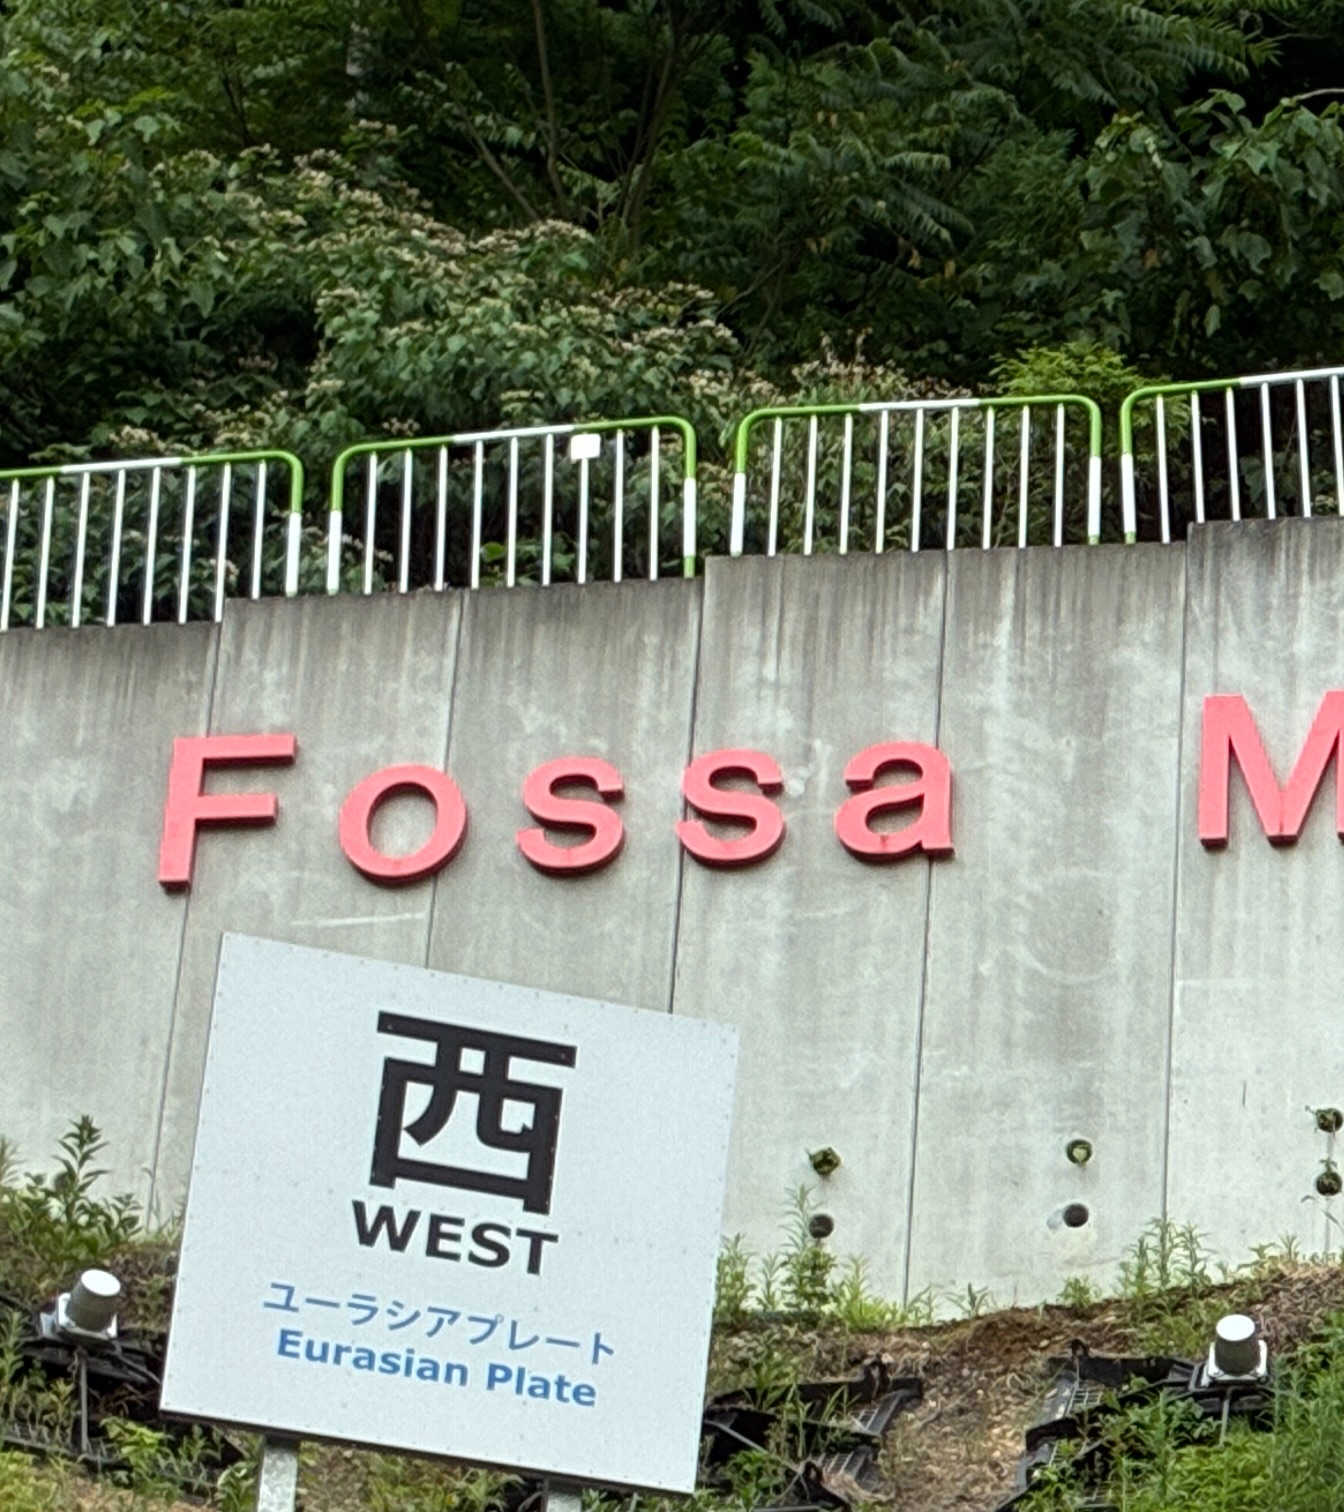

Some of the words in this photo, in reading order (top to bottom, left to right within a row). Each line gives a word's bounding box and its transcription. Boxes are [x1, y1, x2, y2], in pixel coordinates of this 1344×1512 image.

[155, 733, 957, 892] Fossa
[368, 1009, 579, 1215] 西
[351, 1199, 559, 1276] WEST
[262, 1281, 616, 1366] ユーラシアプレート
[276, 1327, 469, 1387] Eurasian
[485, 1362, 598, 1408] Plate
